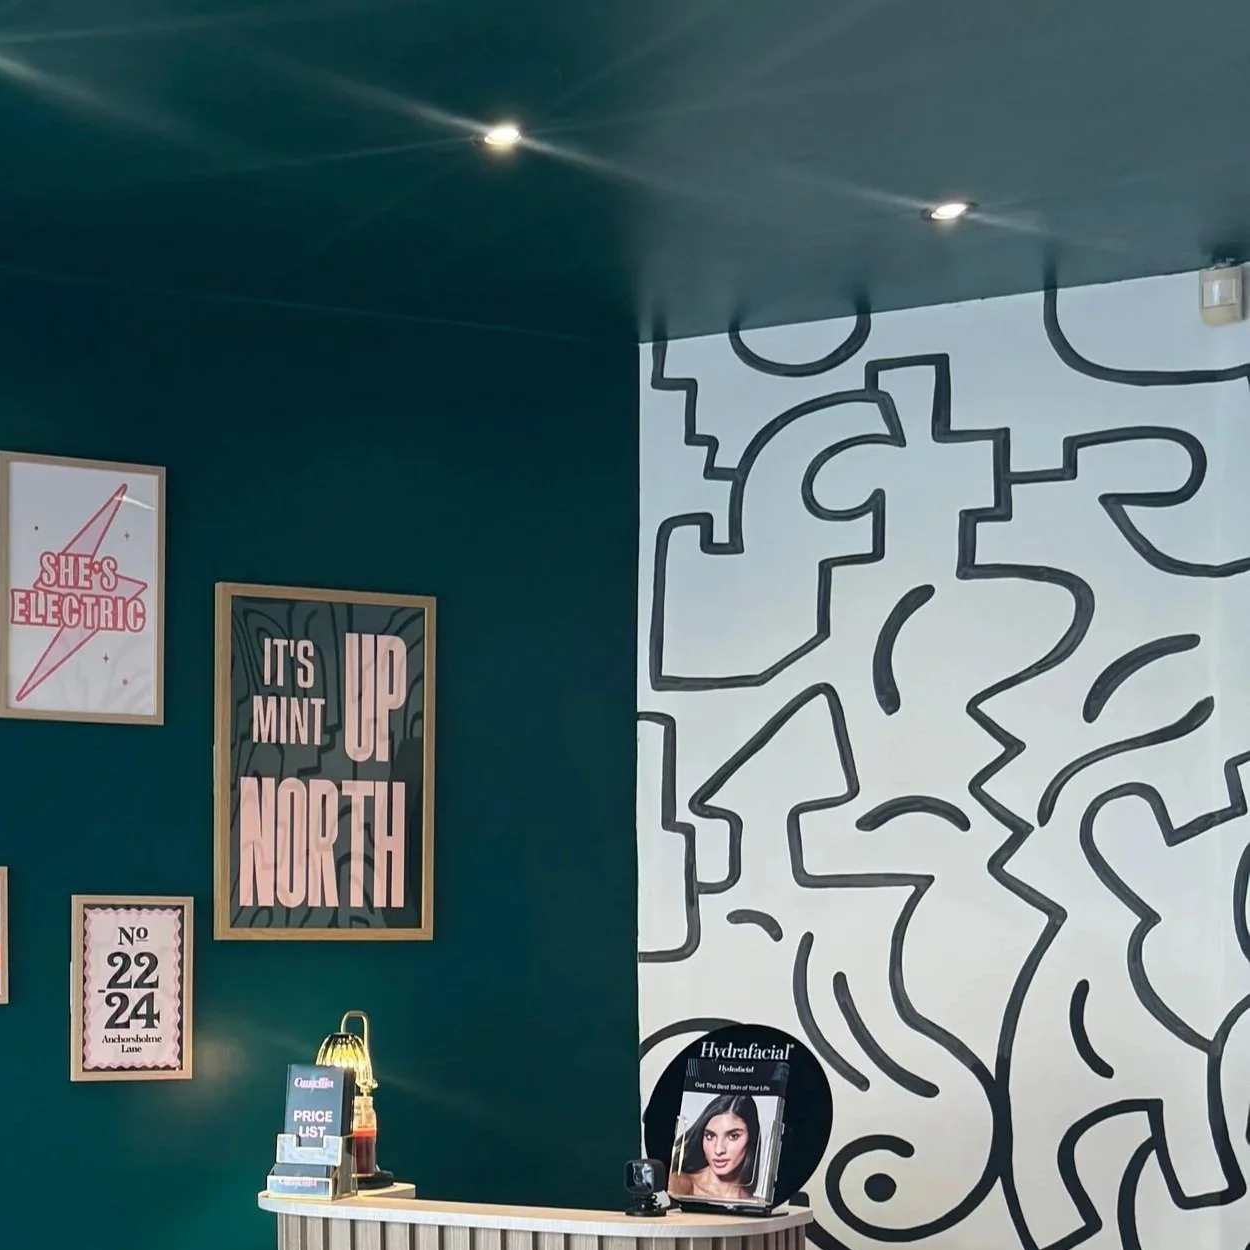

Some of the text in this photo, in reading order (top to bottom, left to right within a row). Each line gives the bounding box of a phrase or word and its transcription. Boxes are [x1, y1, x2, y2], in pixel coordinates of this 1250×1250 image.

[39, 551, 118, 592] SHE'S
[10, 588, 147, 632] ELECTRIC
[263, 637, 314, 689] IT'S
[344, 632, 407, 762] UP
[252, 695, 326, 745] MINT
[239, 776, 406, 909] NORTH
[106, 951, 160, 989] 22
[102, 1034, 163, 1044] Anchorsholme
[121, 1044, 143, 1054] Lane
[694, 1081, 705, 1089] Get
[293, 1110, 334, 1123] PRICE
[299, 1125, 326, 1138] LIST
